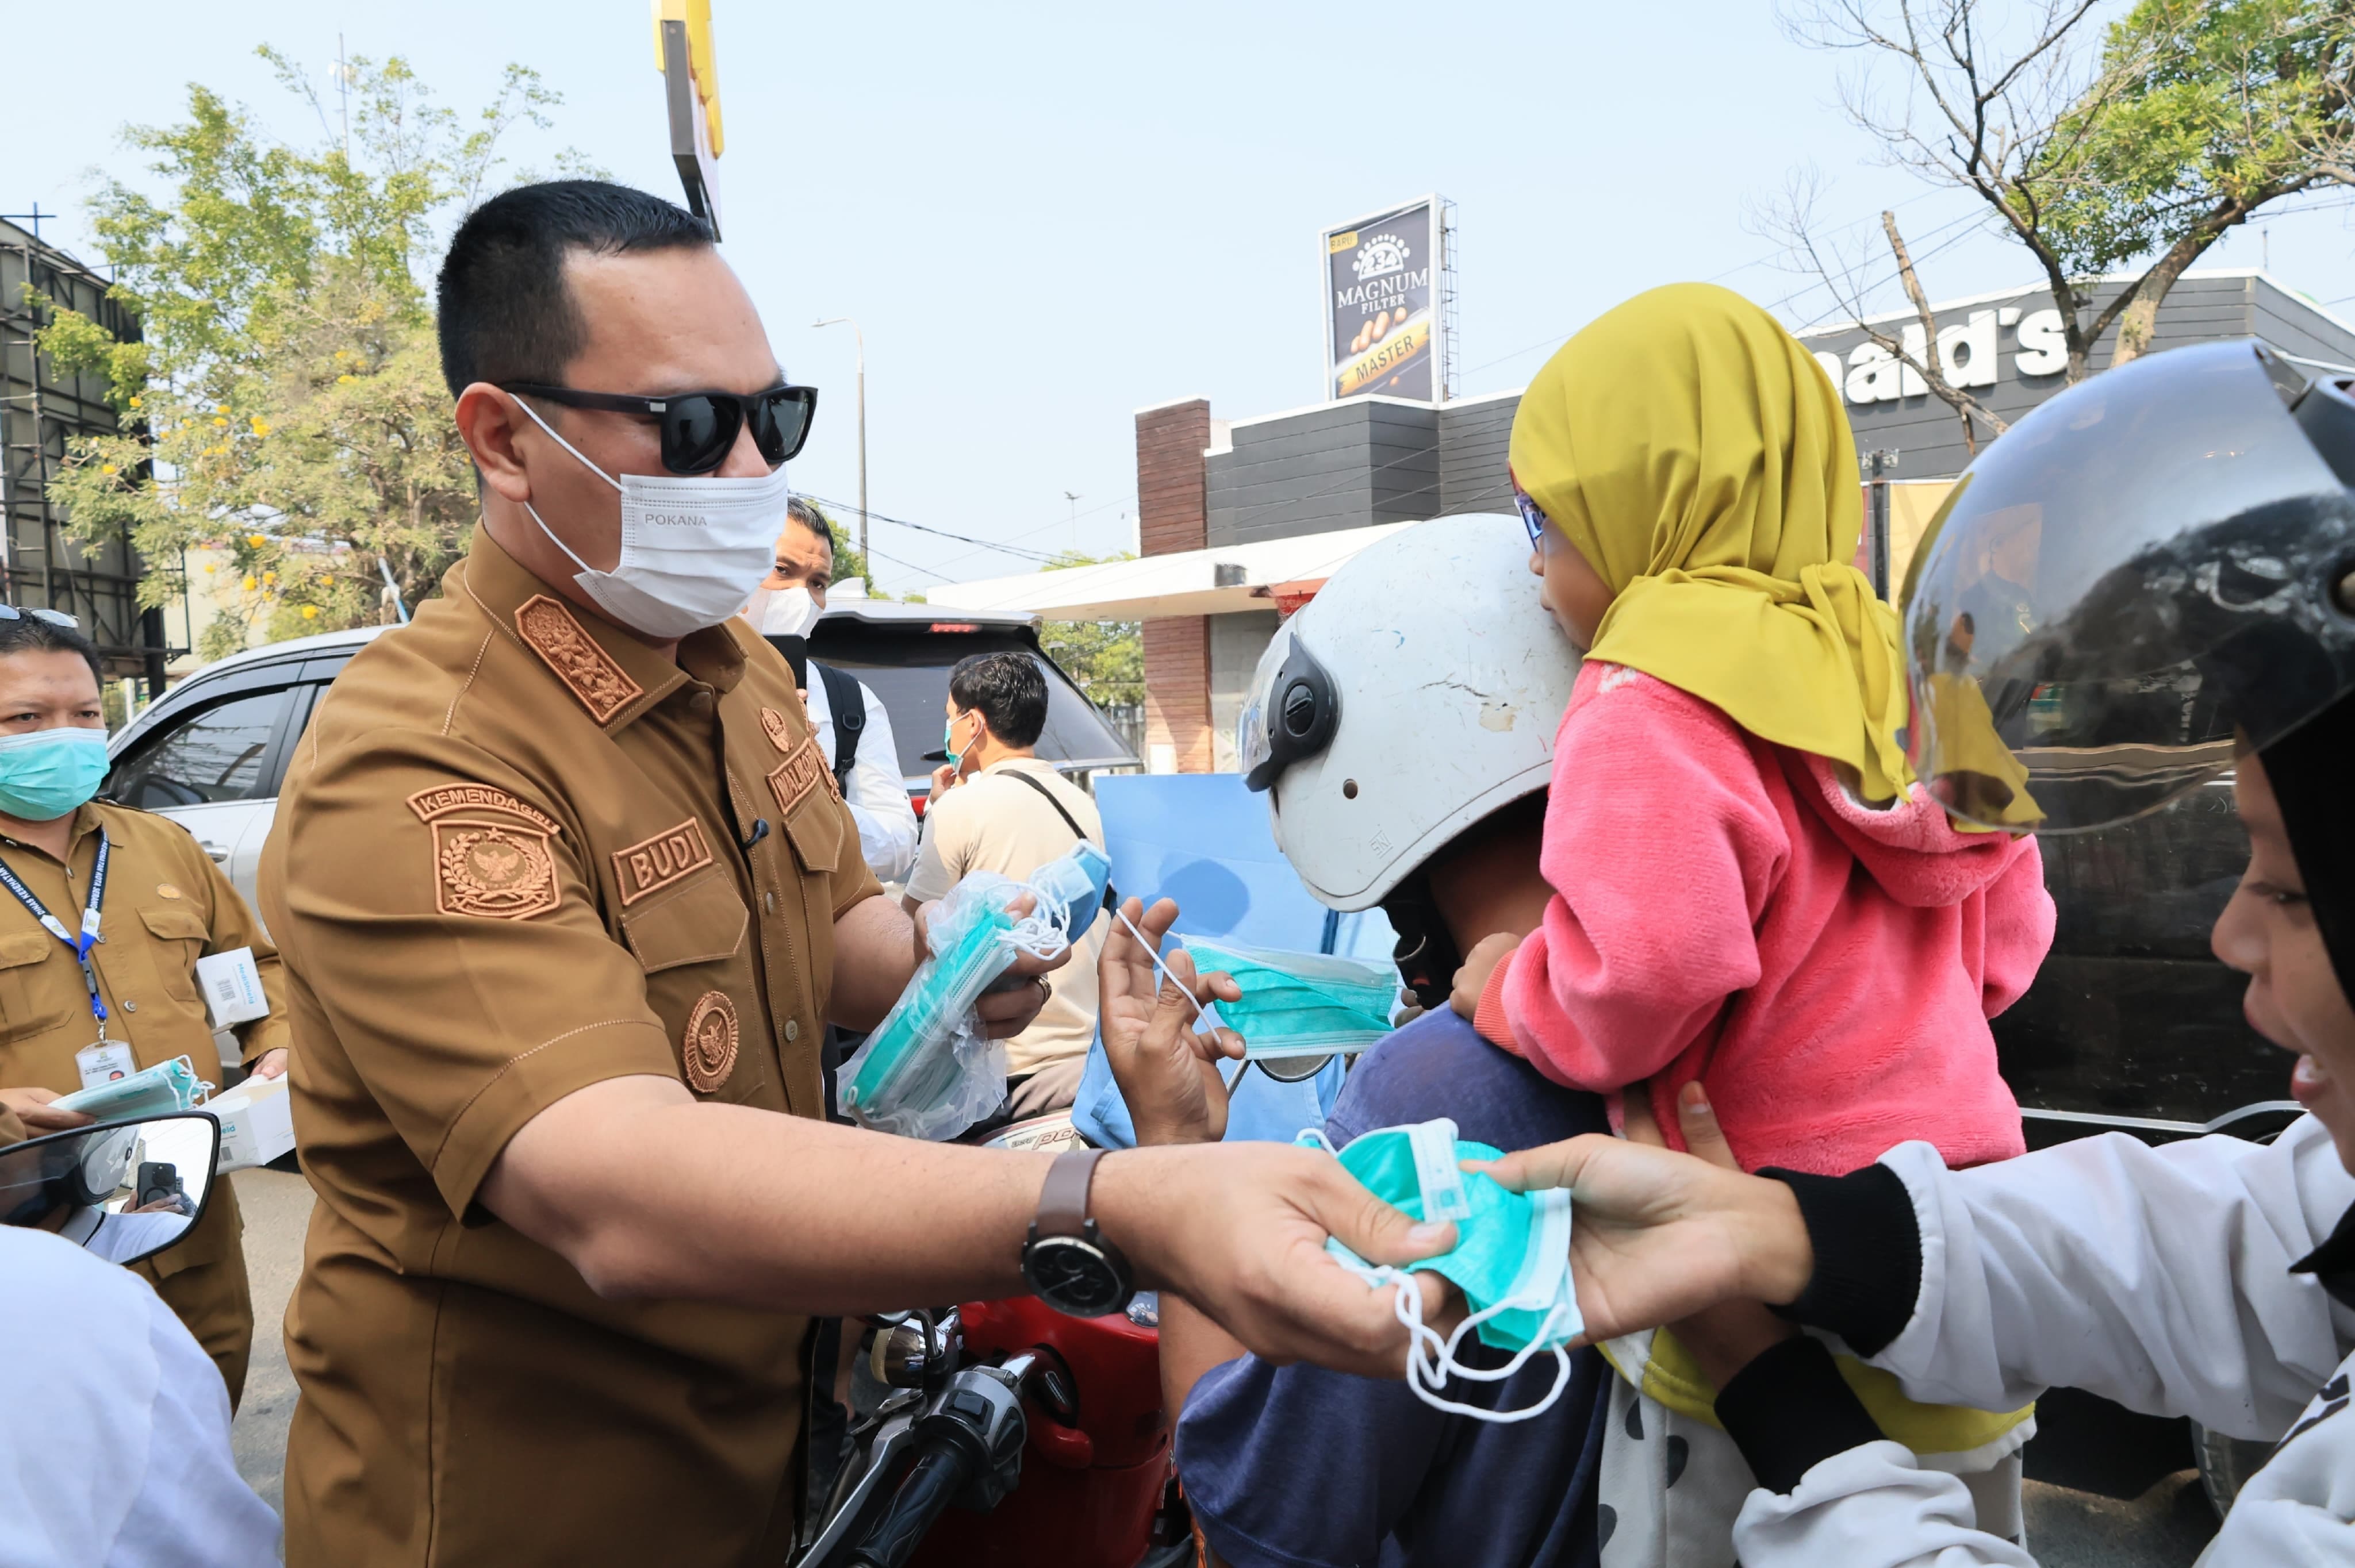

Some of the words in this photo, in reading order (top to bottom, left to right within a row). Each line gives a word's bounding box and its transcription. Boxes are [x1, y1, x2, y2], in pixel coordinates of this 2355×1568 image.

[1330, 235, 1353, 249] BARU
[1363, 250, 1398, 274] 234
[1337, 268, 1429, 309] MAGNUM
[1361, 294, 1405, 314] FILTER
[1356, 336, 1414, 382] MASTER
[645, 513, 707, 526] POKANA
[419, 789, 550, 825] KEMENDAGRI
[630, 829, 701, 889] BUDI
[93, 872, 103, 887] KOTA
[26, 898, 46, 916] DINAS
[90, 886, 101, 909] SERANG
[237, 963, 255, 1005] MediShield
